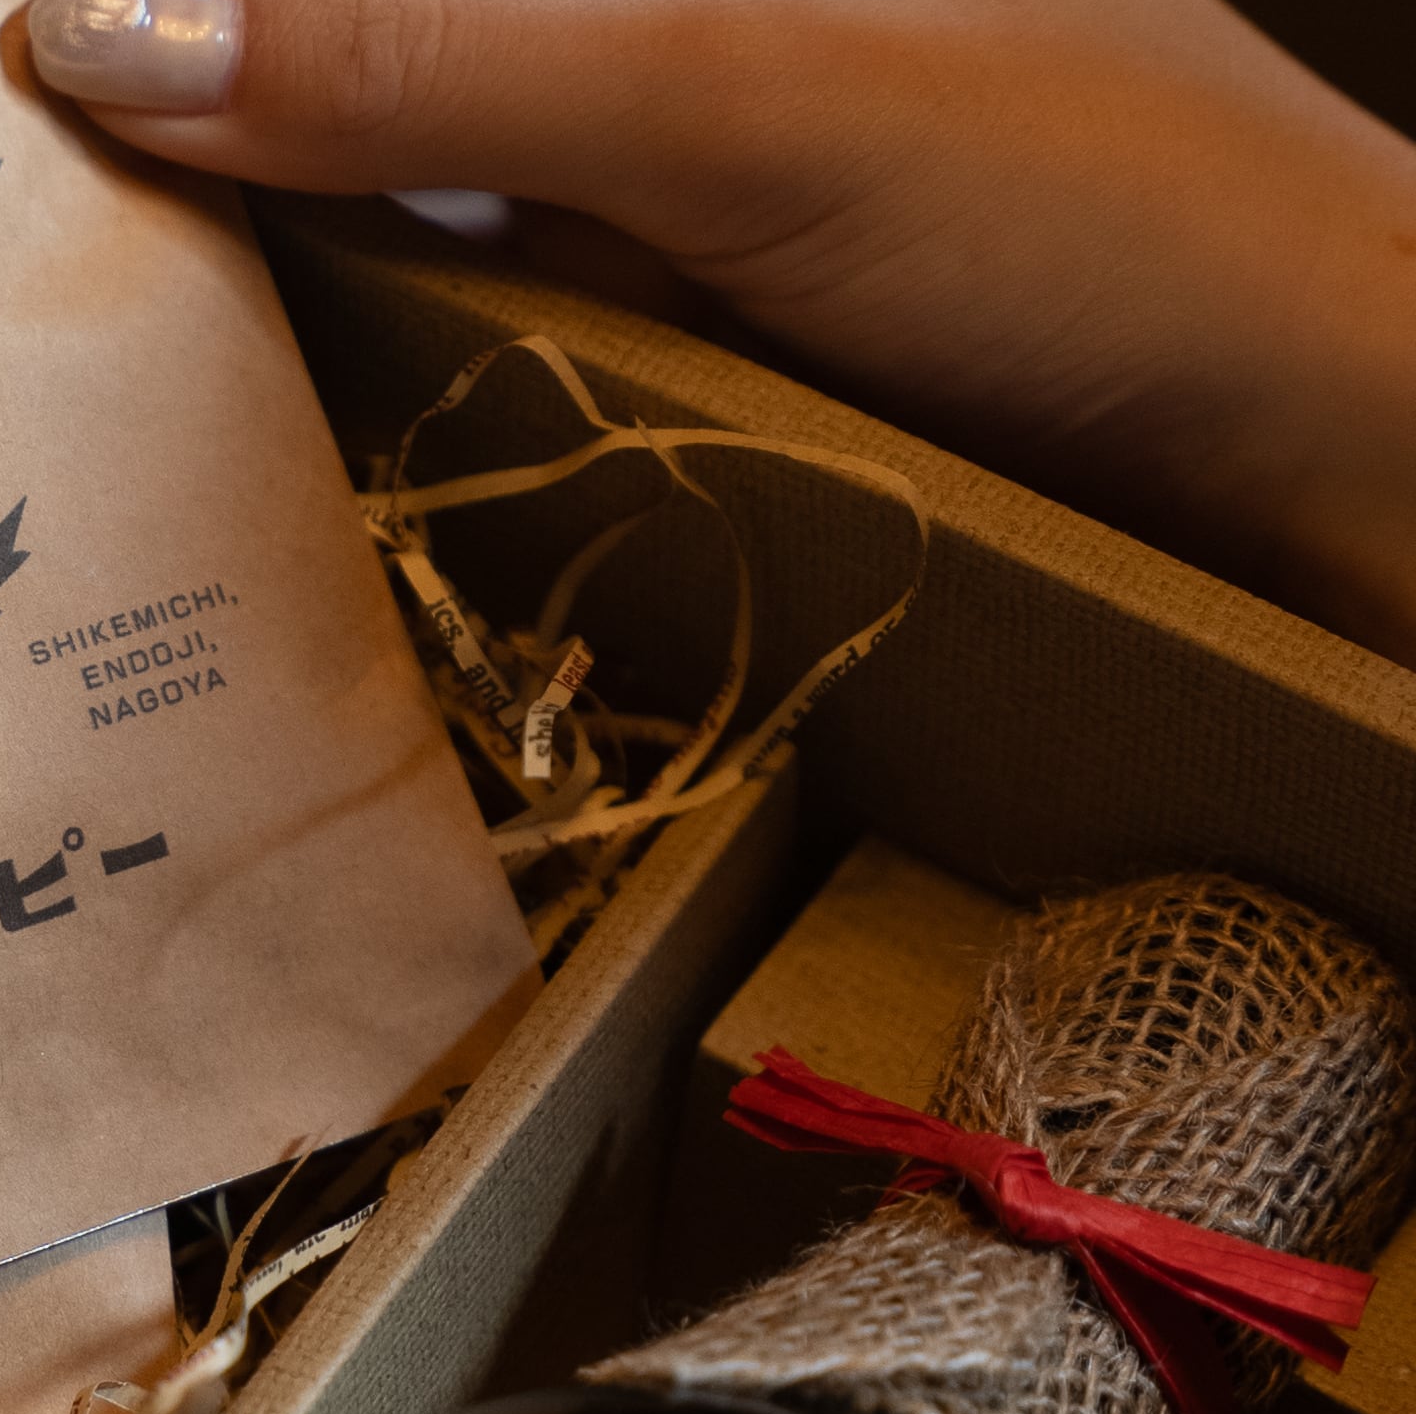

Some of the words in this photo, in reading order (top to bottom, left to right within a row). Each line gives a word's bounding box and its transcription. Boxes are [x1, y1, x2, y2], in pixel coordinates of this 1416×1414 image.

[27, 582, 240, 666] SHIKEMICHI,
[80, 629, 219, 691] ENDOJI,
[87, 666, 228, 731] NAGOYA
